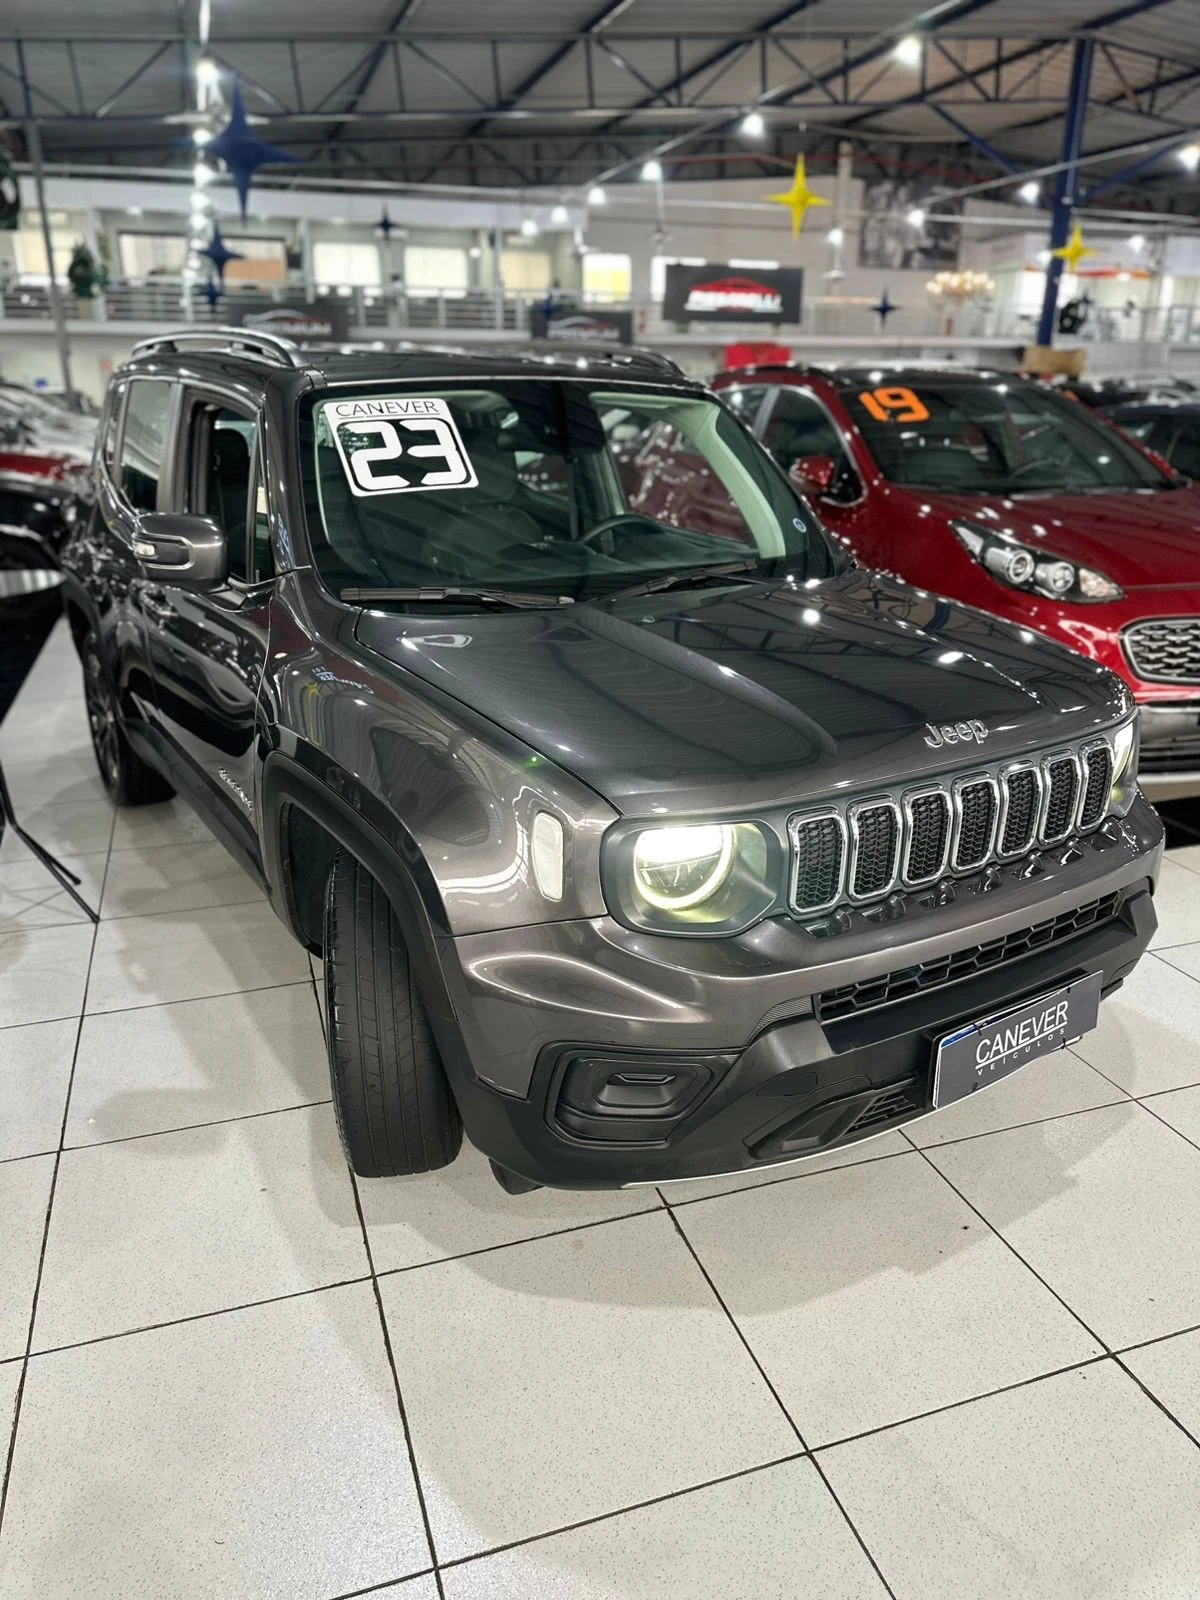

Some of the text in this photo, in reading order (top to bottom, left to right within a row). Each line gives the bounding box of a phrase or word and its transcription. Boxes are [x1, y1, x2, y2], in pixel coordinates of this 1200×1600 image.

[336, 400, 438, 417] CANEVER
[859, 387, 930, 422] 19
[344, 419, 467, 490] 23
[924, 719, 989, 748] Jeep
[975, 1000, 1069, 1064] CANEVER
